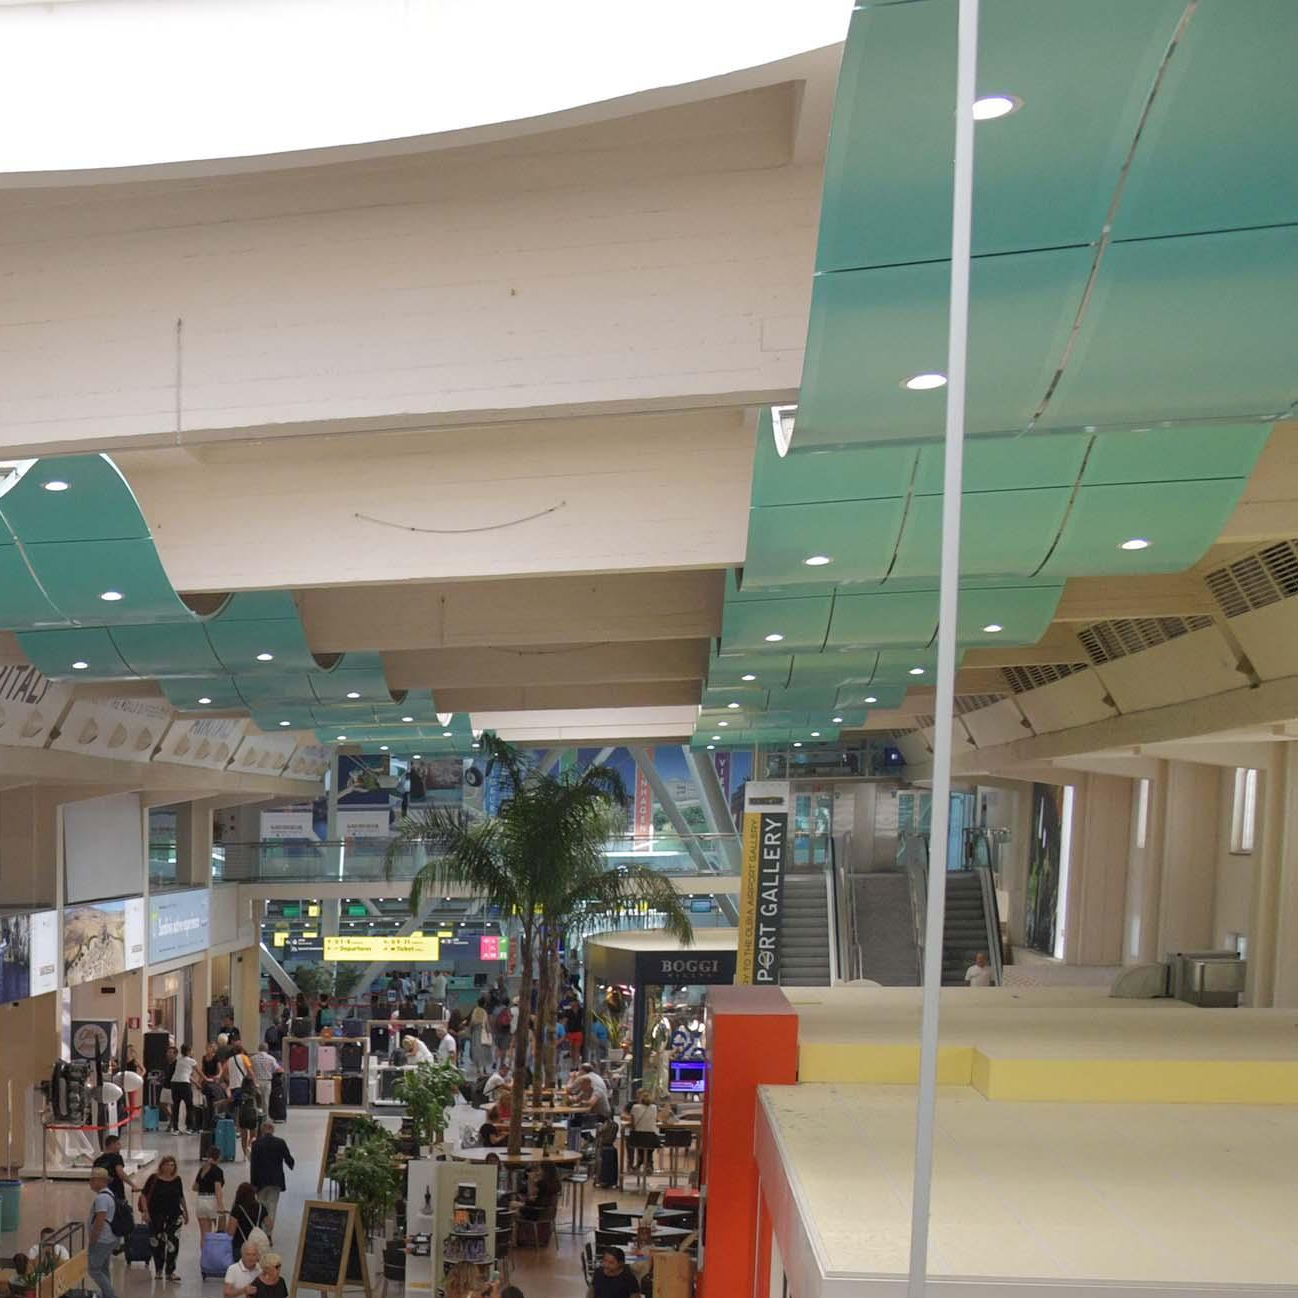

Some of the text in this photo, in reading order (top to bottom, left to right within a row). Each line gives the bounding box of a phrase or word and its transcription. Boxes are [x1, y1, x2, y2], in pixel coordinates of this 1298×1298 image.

[760, 817, 783, 917] GALLERY
[661, 959, 719, 973] BOGGI
[757, 923, 776, 982] PORT
